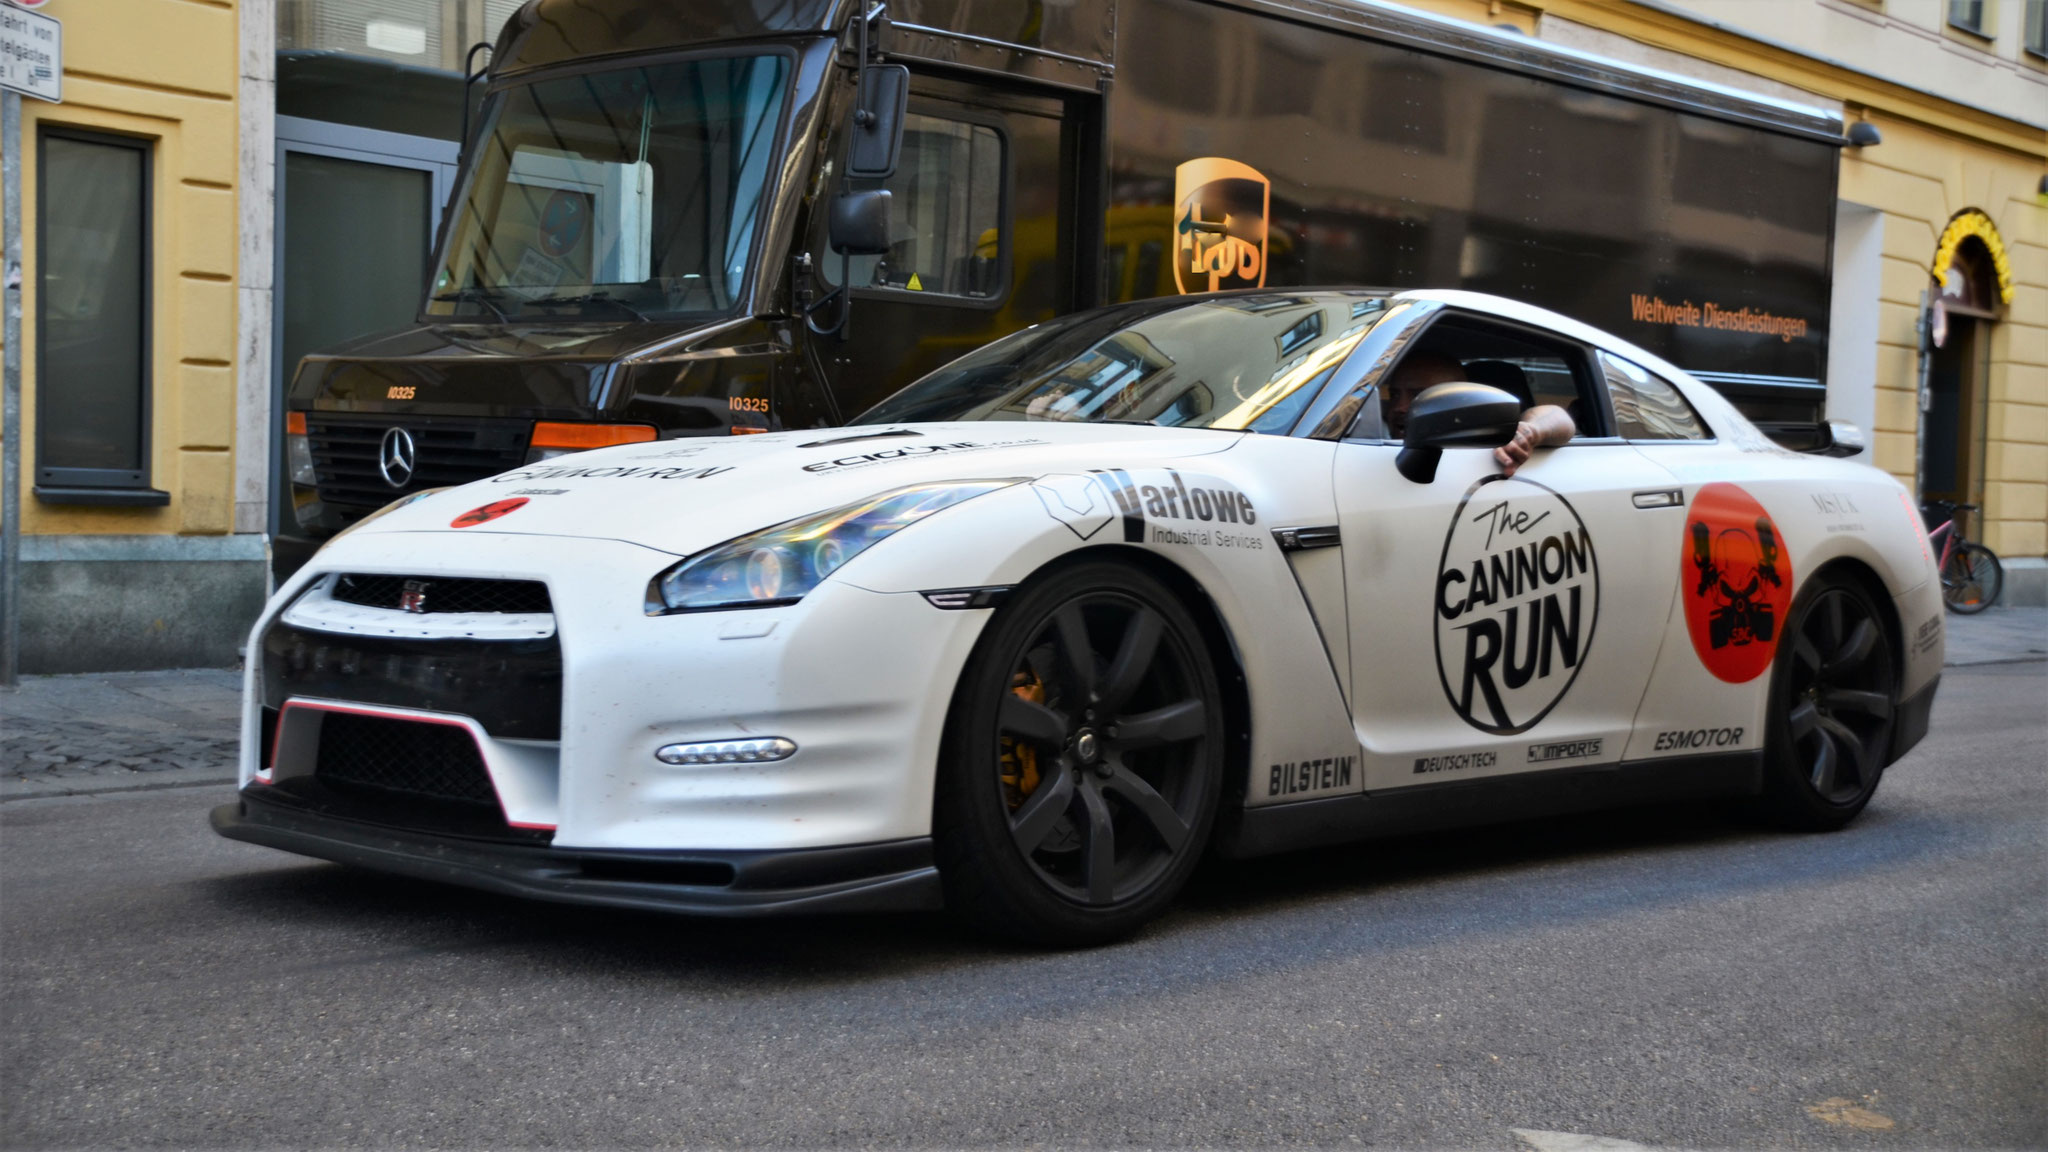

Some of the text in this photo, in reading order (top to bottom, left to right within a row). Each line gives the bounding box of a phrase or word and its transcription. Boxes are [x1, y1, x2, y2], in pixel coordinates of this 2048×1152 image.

[33, 25, 53, 42] von
[1631, 293, 1807, 344] Weltweite Dienstleistungen
[386, 385, 417, 400] 10325
[728, 396, 769, 413] 10325
[1087, 467, 1257, 543] Varlowe
[1152, 526, 1212, 546] Industrial
[1215, 530, 1264, 550] Services
[1472, 500, 1551, 551] The
[1437, 527, 1589, 620] CANNON
[1450, 584, 1582, 731] RUN
[1653, 727, 1744, 751] ESMOTOR
[1269, 756, 1351, 796] BILSTEIN
